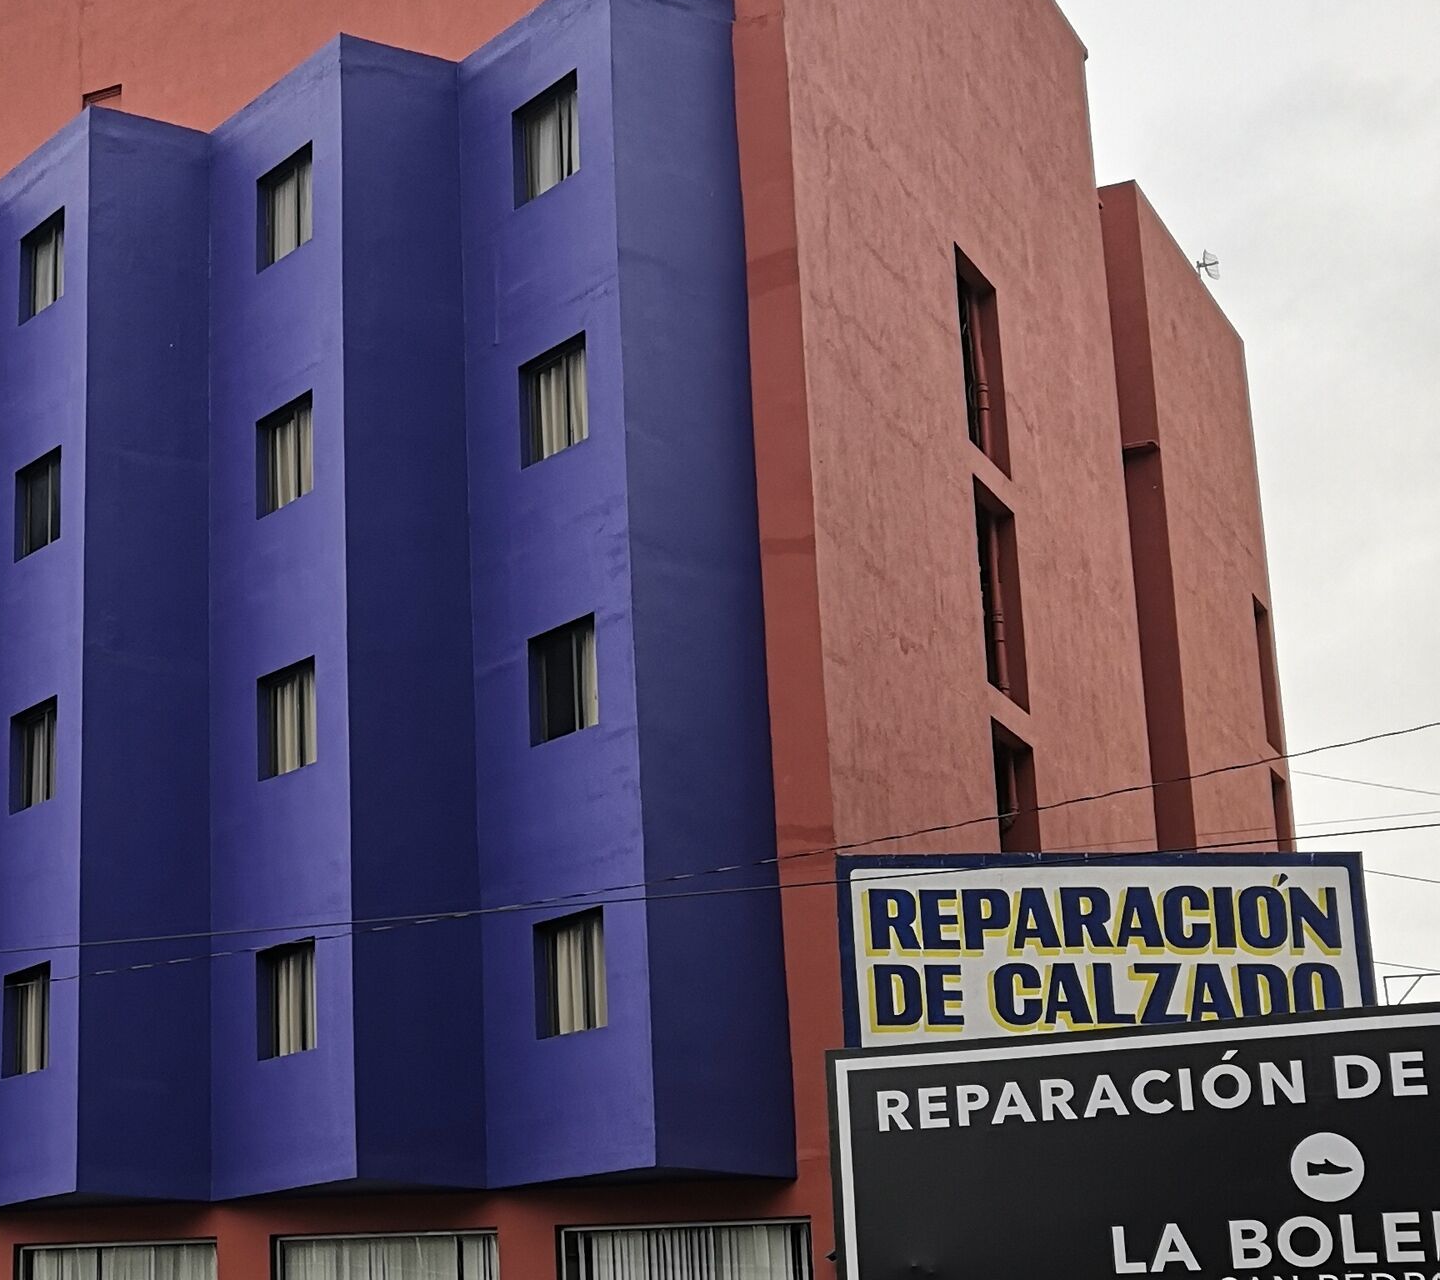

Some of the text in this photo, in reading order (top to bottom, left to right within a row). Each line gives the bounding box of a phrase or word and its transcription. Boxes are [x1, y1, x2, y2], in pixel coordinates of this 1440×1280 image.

[866, 873, 1342, 956] REPARACIÓN
[870, 962, 1344, 1032] DE CALZADO
[876, 1049, 1429, 1132] REPARACIÓN DE
[1111, 1210, 1440, 1274] LA BOLE
